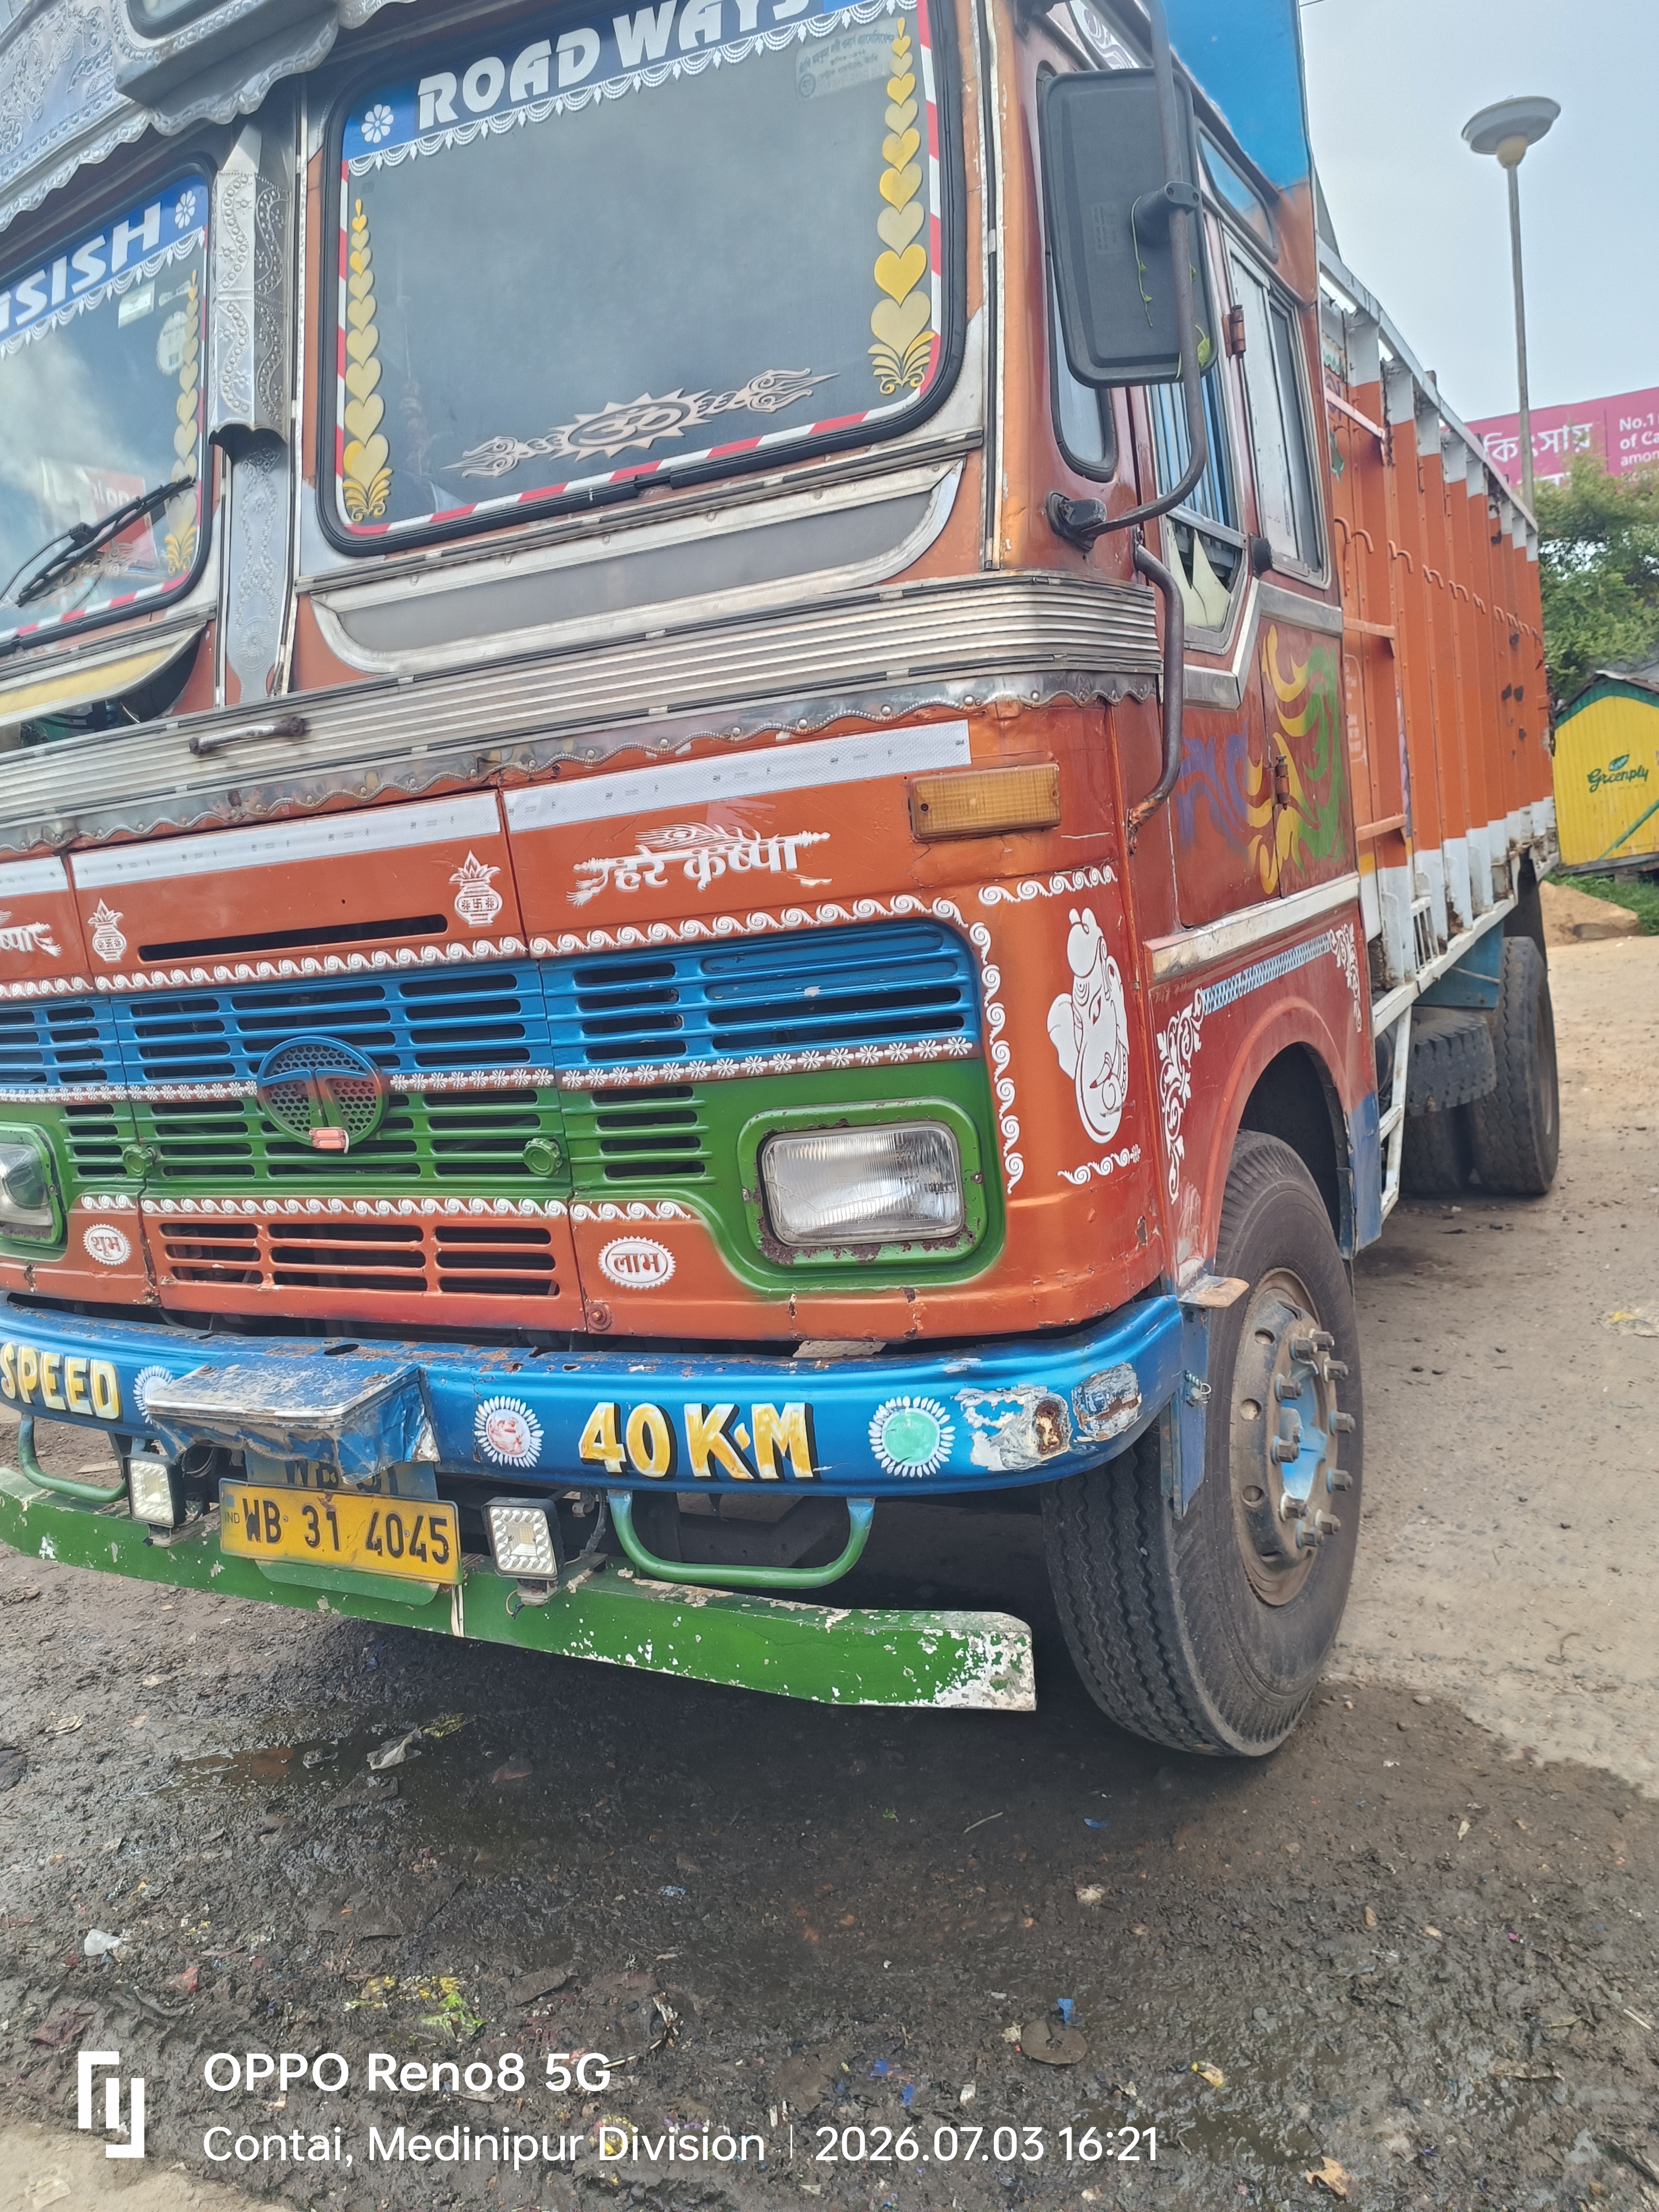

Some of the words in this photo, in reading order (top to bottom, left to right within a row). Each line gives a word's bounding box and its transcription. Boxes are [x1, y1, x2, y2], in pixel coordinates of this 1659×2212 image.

[418, 26, 602, 130] ROAD
[1620, 413, 1654, 431] No.1
[1620, 433, 1637, 450] of
[1587, 765, 1649, 793] Greenply
[611, 1253, 660, 1274] लाभ
[0, 1342, 122, 1420] SPEED
[578, 1401, 671, 1479] 40
[225, 1512, 240, 1524] IND
[242, 1498, 283, 1544] WB
[302, 1505, 340, 1551] 31
[366, 1510, 450, 1564] 4045
